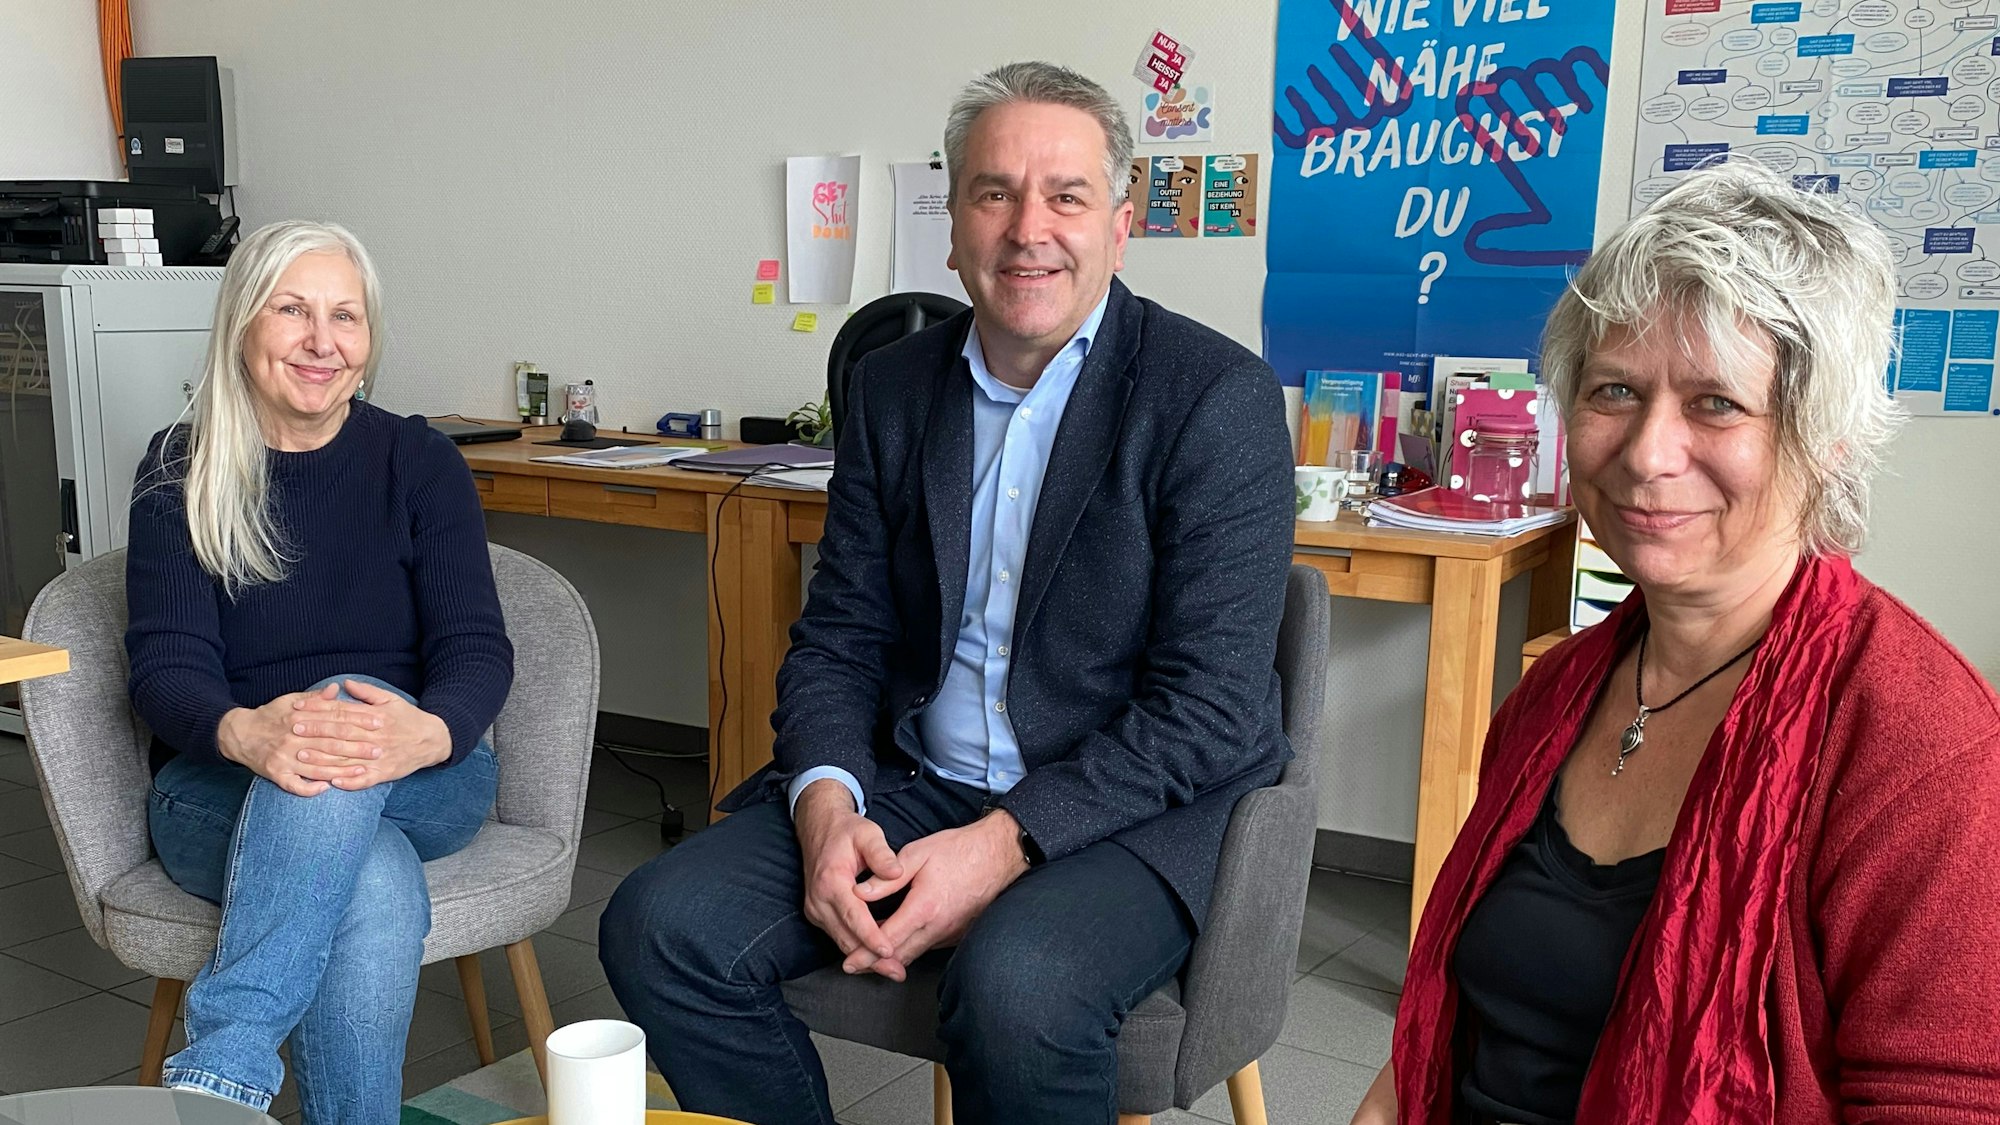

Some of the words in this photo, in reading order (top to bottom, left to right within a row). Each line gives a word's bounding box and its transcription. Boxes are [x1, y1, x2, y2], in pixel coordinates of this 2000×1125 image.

[1337, 0, 1430, 41] WIE
[1453, 0, 1550, 27] VIEL
[1156, 34, 1177, 53] NUR
[1171, 52, 1182, 67] JA
[1150, 57, 1181, 82] HEISST
[1363, 39, 1506, 107] NÄHE
[1158, 77, 1170, 91] JA
[1160, 101, 1196, 115] Consent
[1299, 103, 1579, 179] BRAUCHST
[1154, 179, 1166, 187] EIN
[1214, 180, 1229, 189] EINE
[813, 181, 849, 204] GET
[1159, 189, 1182, 197] OUTFIT
[1207, 190, 1243, 199] BEZIEHUNG
[1150, 200, 1162, 208] IST
[1162, 200, 1177, 208] KEIN
[1209, 202, 1220, 210] IST
[1220, 203, 1235, 211] KEIN
[1170, 208, 1179, 216] JA
[1231, 209, 1240, 217] JA
[1394, 185, 1471, 239] DU
[1417, 251, 1447, 305] ?
